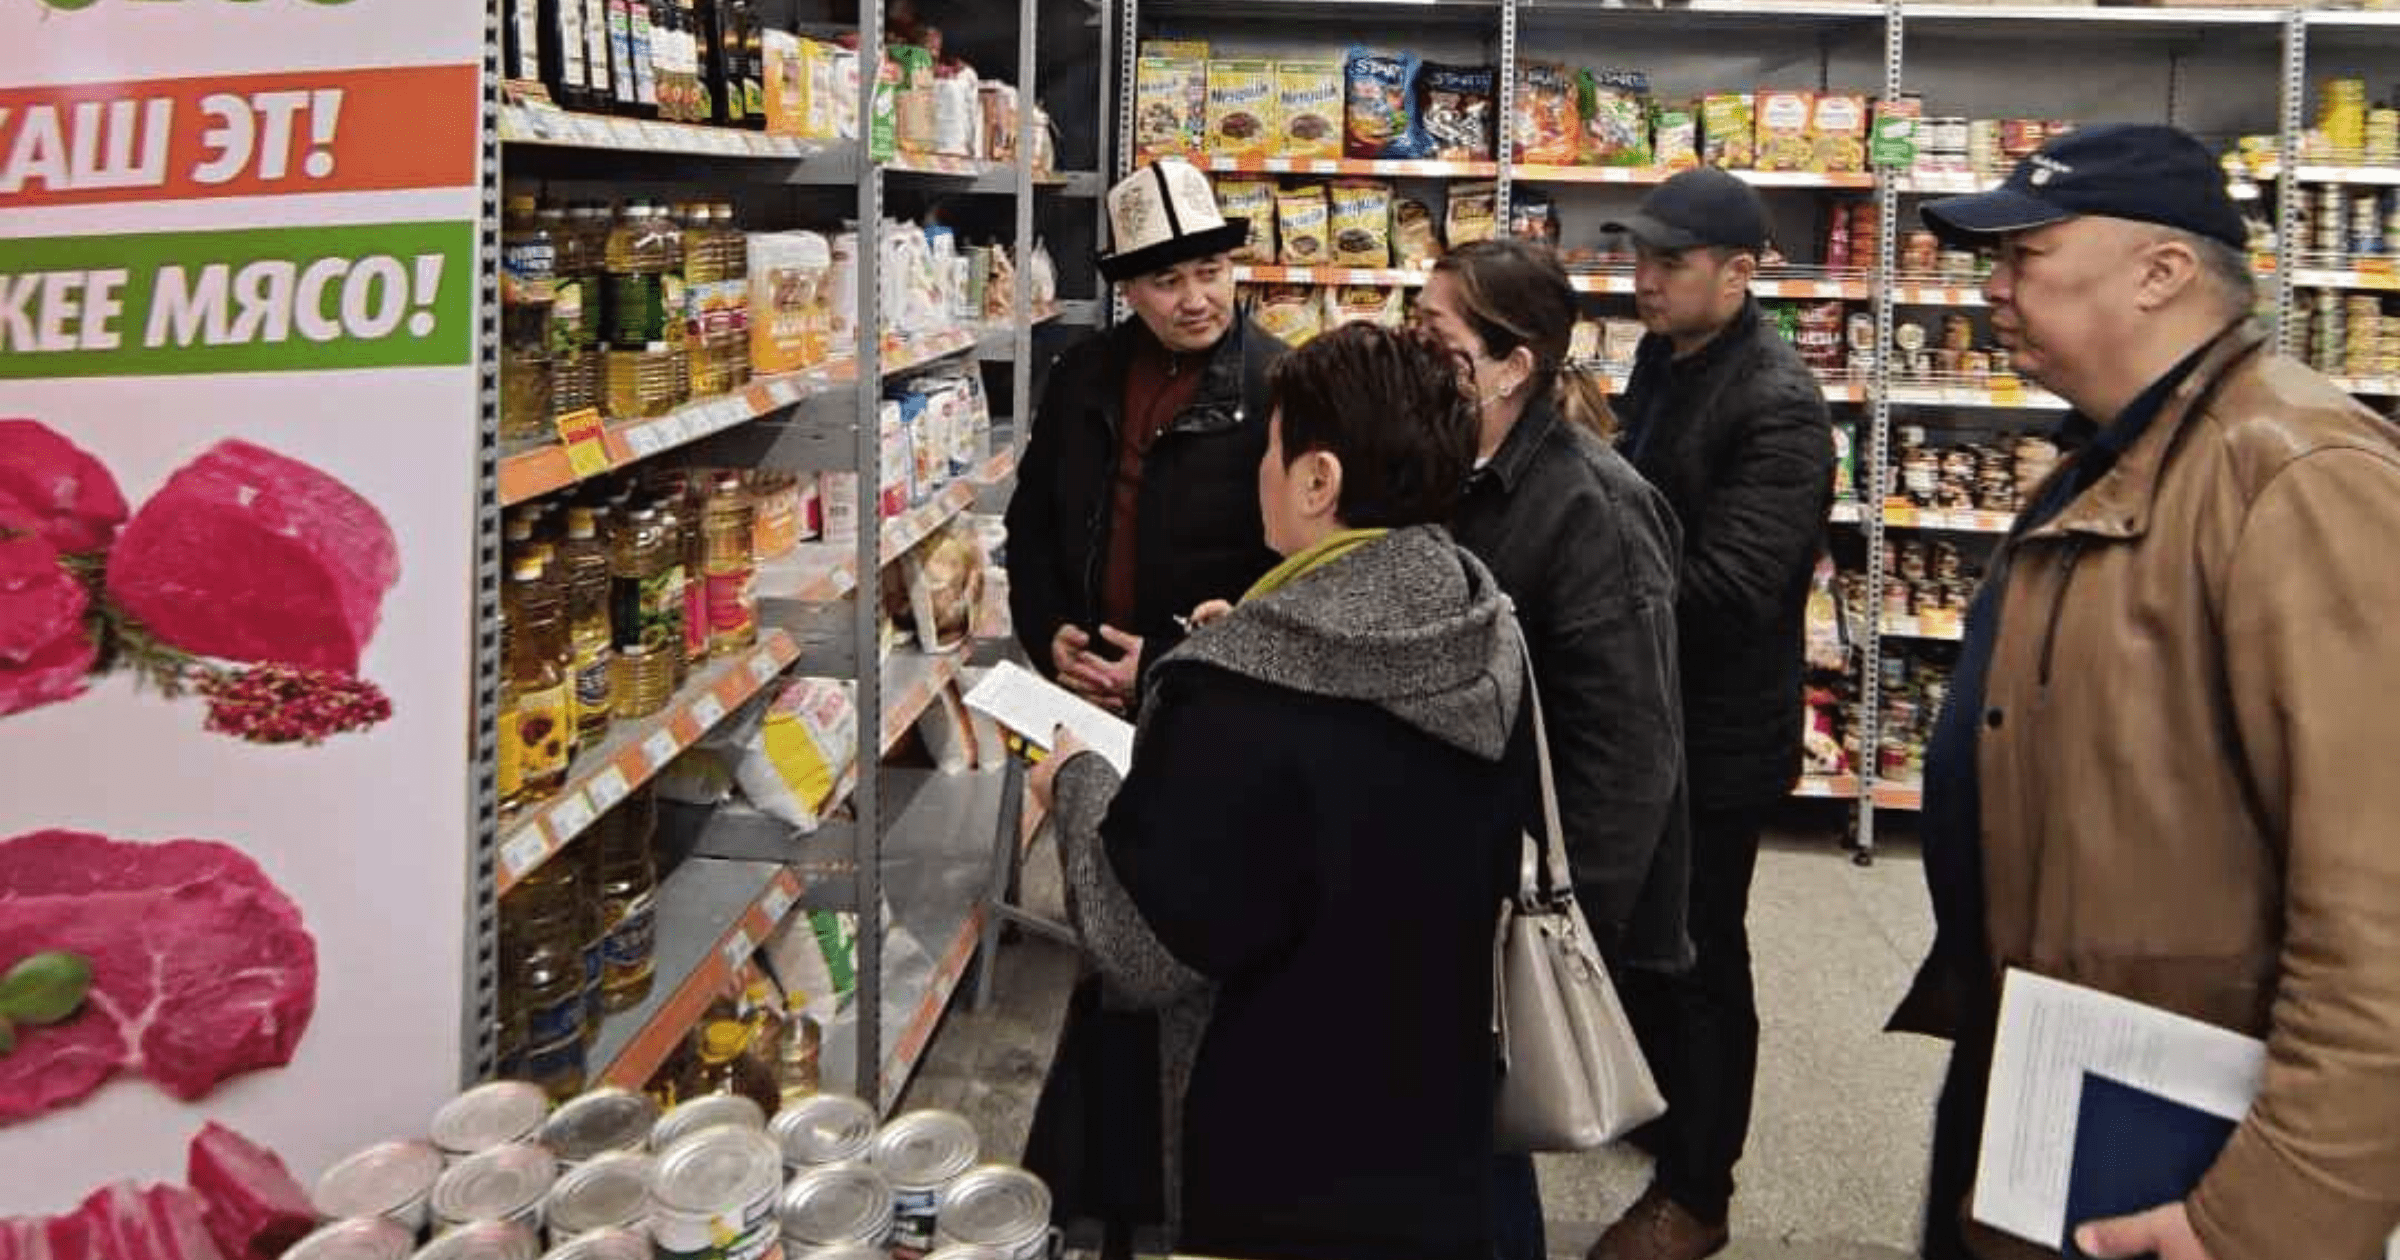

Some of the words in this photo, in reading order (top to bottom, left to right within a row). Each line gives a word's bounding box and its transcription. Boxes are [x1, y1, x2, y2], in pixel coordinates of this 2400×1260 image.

[1211, 82, 1269, 104] Nesquik
[1281, 82, 1338, 104] Nesquik
[190, 88, 345, 184] ЭТ!
[143, 253, 446, 349] МЯСО!
